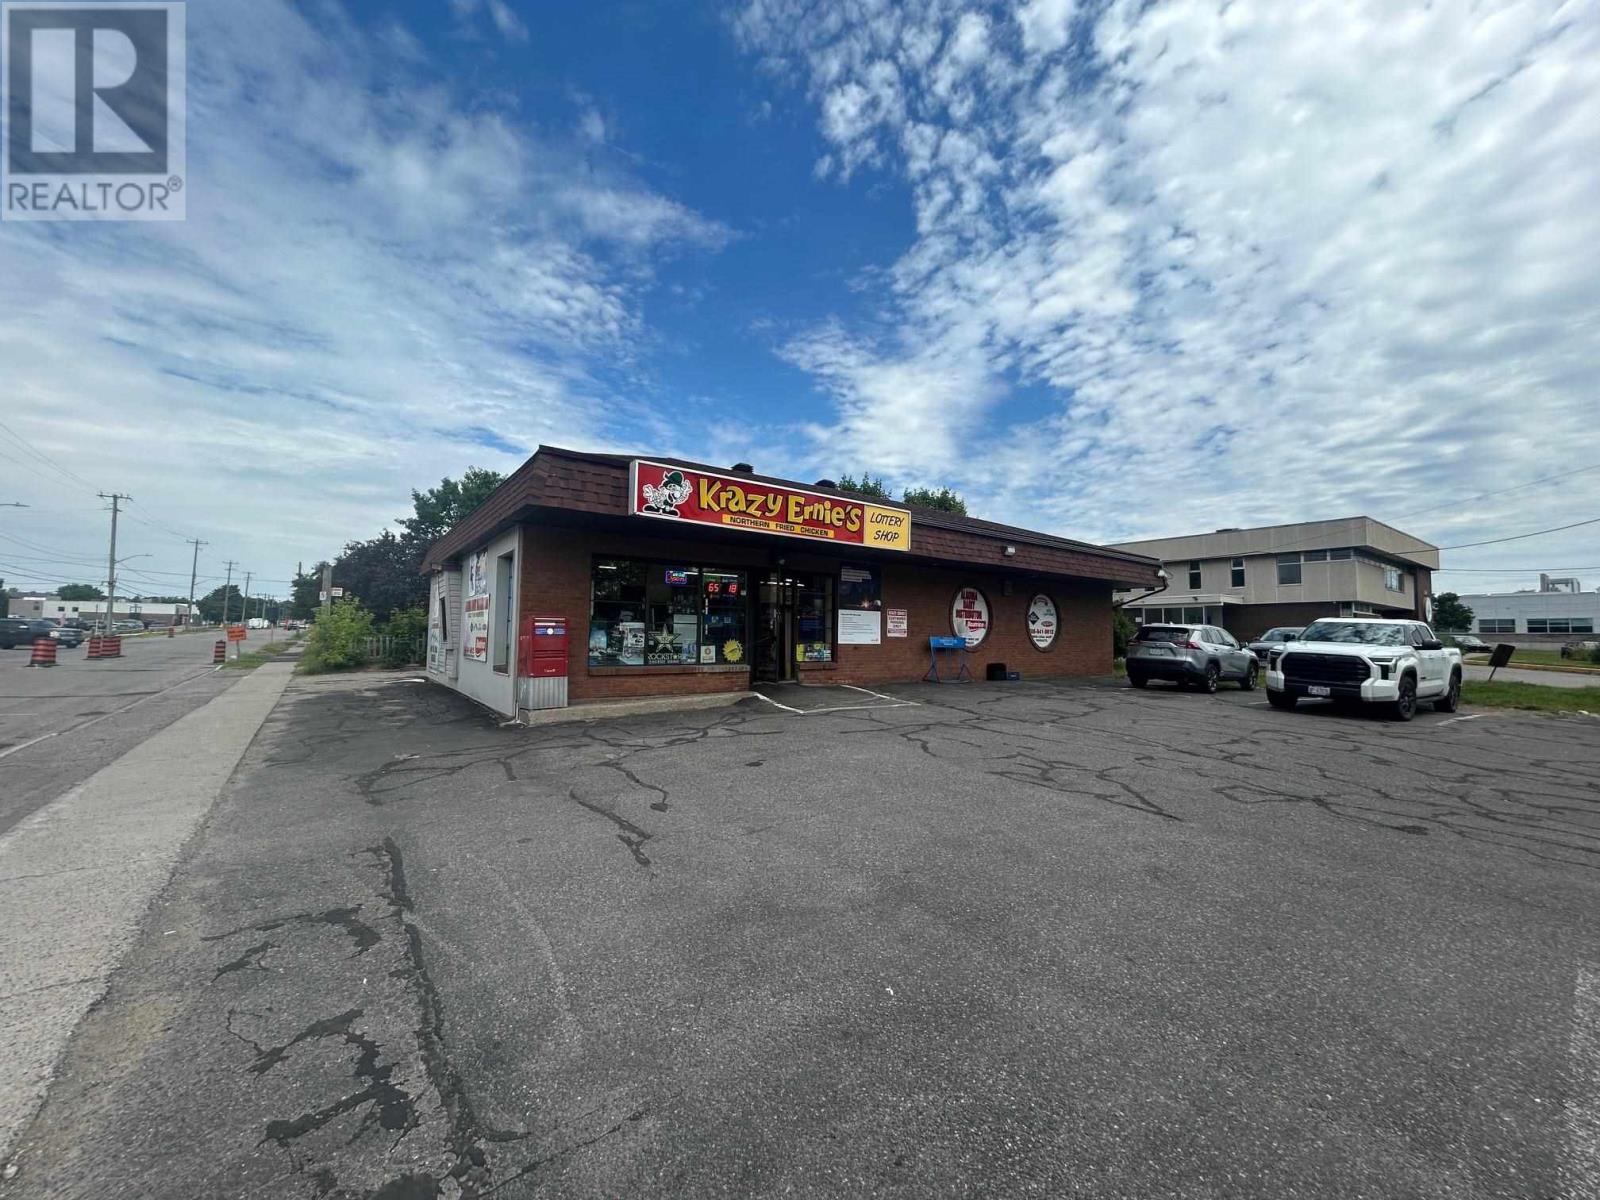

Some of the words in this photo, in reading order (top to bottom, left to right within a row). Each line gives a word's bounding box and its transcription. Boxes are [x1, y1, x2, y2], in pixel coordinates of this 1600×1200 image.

[698, 478, 784, 517] Krazy
[787, 494, 862, 533] Ernie's
[729, 516, 770, 529] NORTHERN
[775, 522, 795, 532] FRIED
[800, 526, 829, 537] CHICKEN
[870, 510, 904, 528] LOTTERY
[873, 528, 900, 542] SHOP
[708, 583, 719, 592] 65
